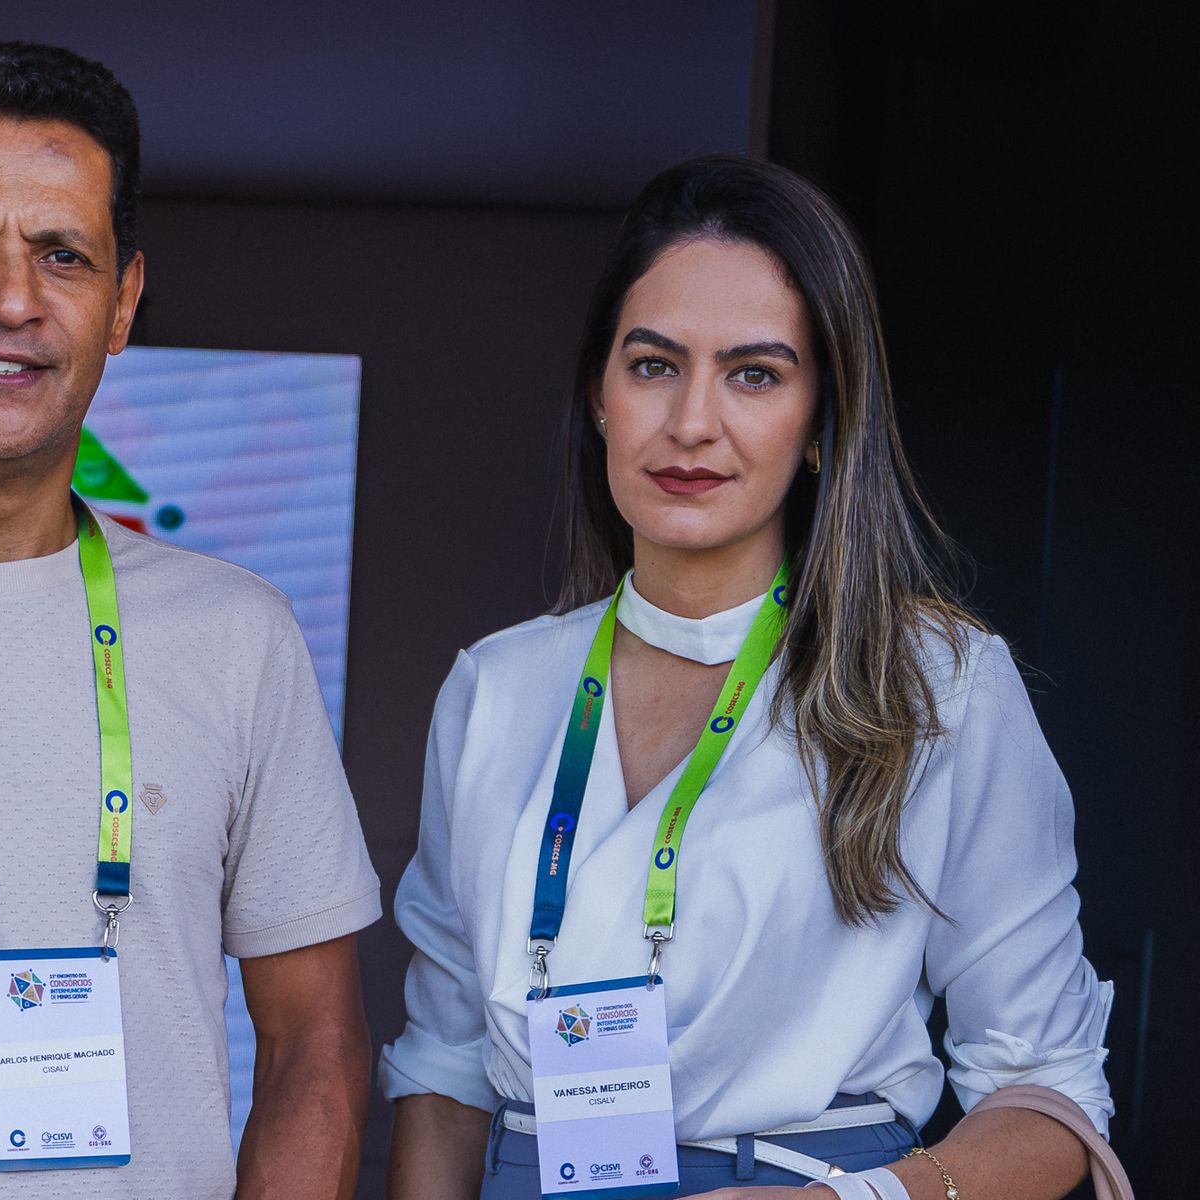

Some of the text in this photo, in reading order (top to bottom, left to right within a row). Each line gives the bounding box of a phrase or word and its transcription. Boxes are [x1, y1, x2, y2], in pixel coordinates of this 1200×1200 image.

[50, 978, 92, 987] CONSÓRCIOS
[597, 1008, 638, 1020] CONSÓRCIOS
[29, 1052, 72, 1062] HENRIQUE
[73, 1048, 115, 1059] MACHADO
[42, 1065, 70, 1074] CISALV
[553, 1080, 651, 1097] VANESSA MEDEIROS
[589, 1097, 616, 1106] CISALV
[52, 1132, 73, 1141] CISVI
[600, 1163, 620, 1172] CISVI
